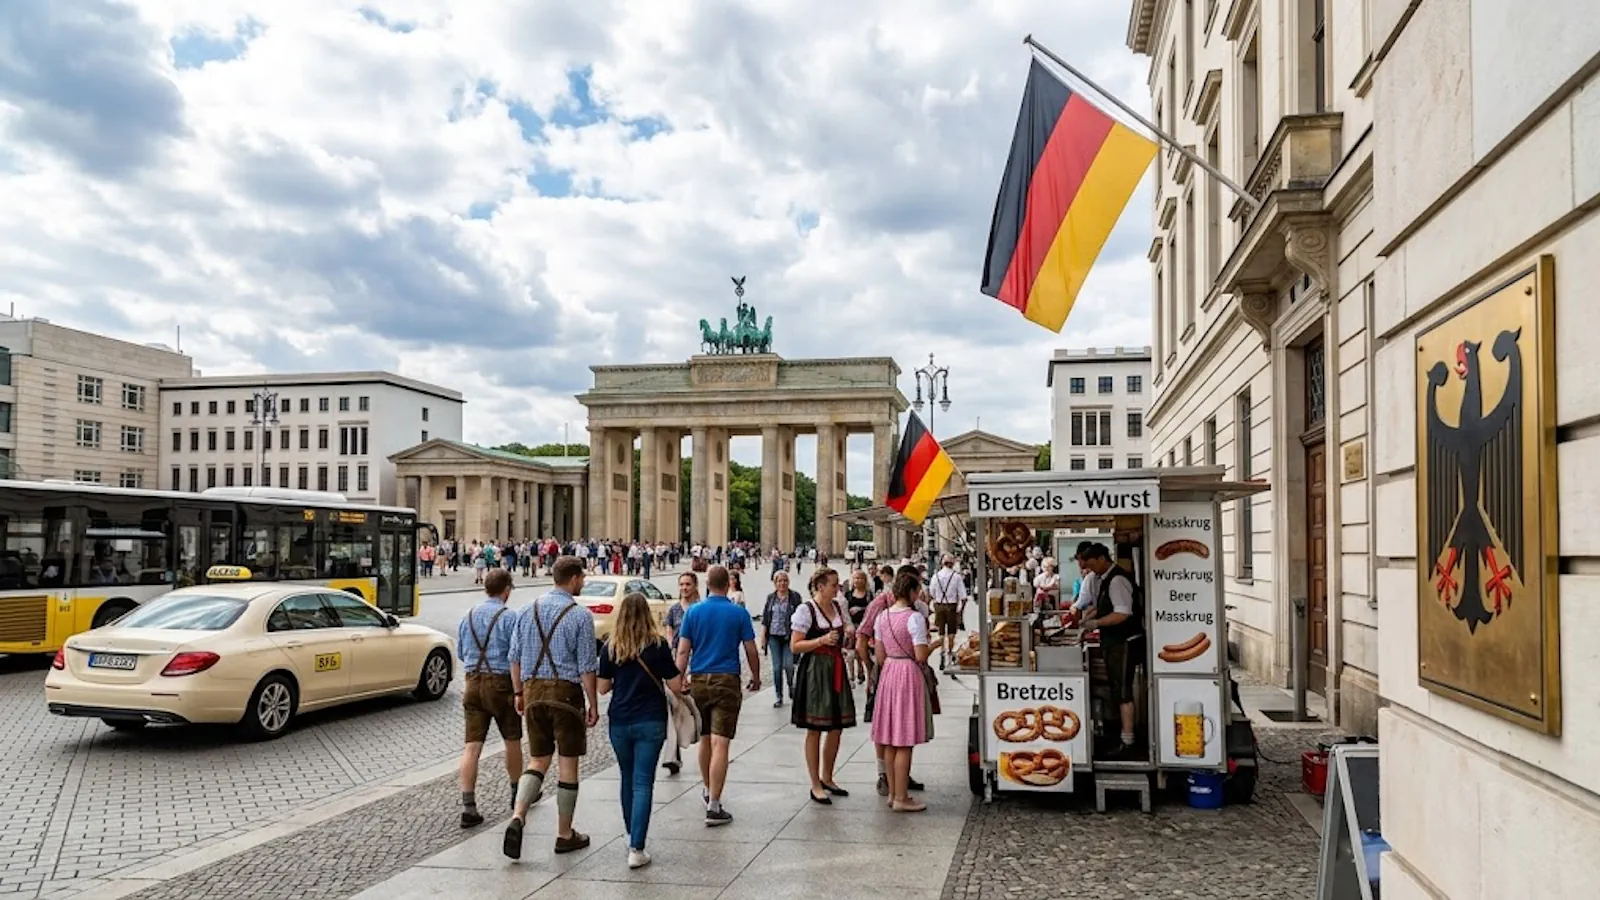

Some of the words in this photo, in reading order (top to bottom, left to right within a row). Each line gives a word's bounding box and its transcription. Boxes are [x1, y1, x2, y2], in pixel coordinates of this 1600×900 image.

[977, 490, 1063, 511] Bretzels
[1084, 489, 1151, 509] Wurst
[1153, 516, 1211, 531] Masskrug
[1169, 590, 1197, 601] Beer
[1156, 610, 1213, 625] Masskrug
[997, 682, 1074, 701] Bretzels
